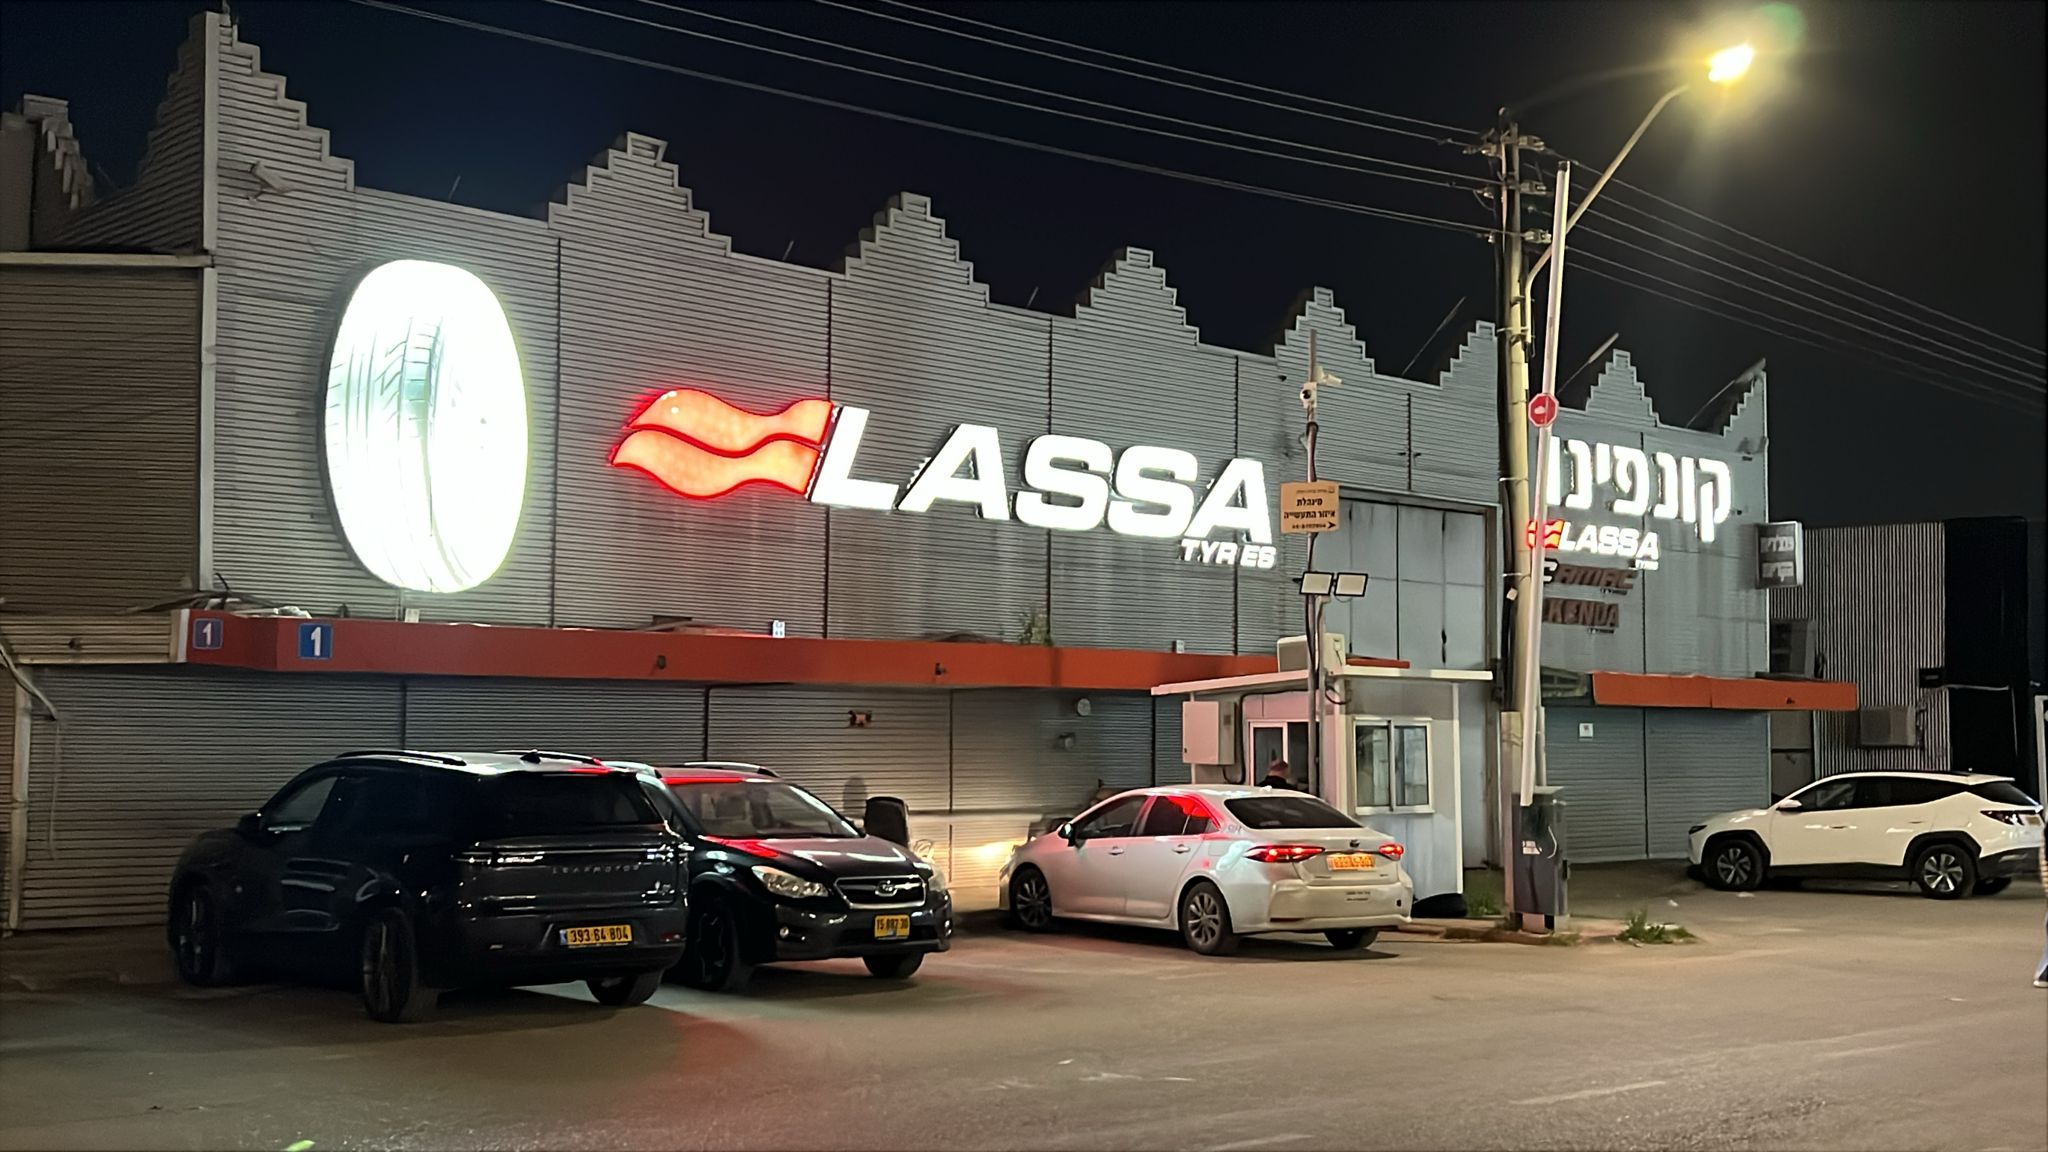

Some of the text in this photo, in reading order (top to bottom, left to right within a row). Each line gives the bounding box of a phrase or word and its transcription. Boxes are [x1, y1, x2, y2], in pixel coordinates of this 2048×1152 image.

[811, 406, 1272, 544] LASSA
[1547, 436, 1731, 542] קונפינו
[1181, 538, 1277, 569] TYRES
[1558, 521, 1659, 560] LASSA
[202, 622, 212, 646] 1
[310, 626, 322, 657] 1
